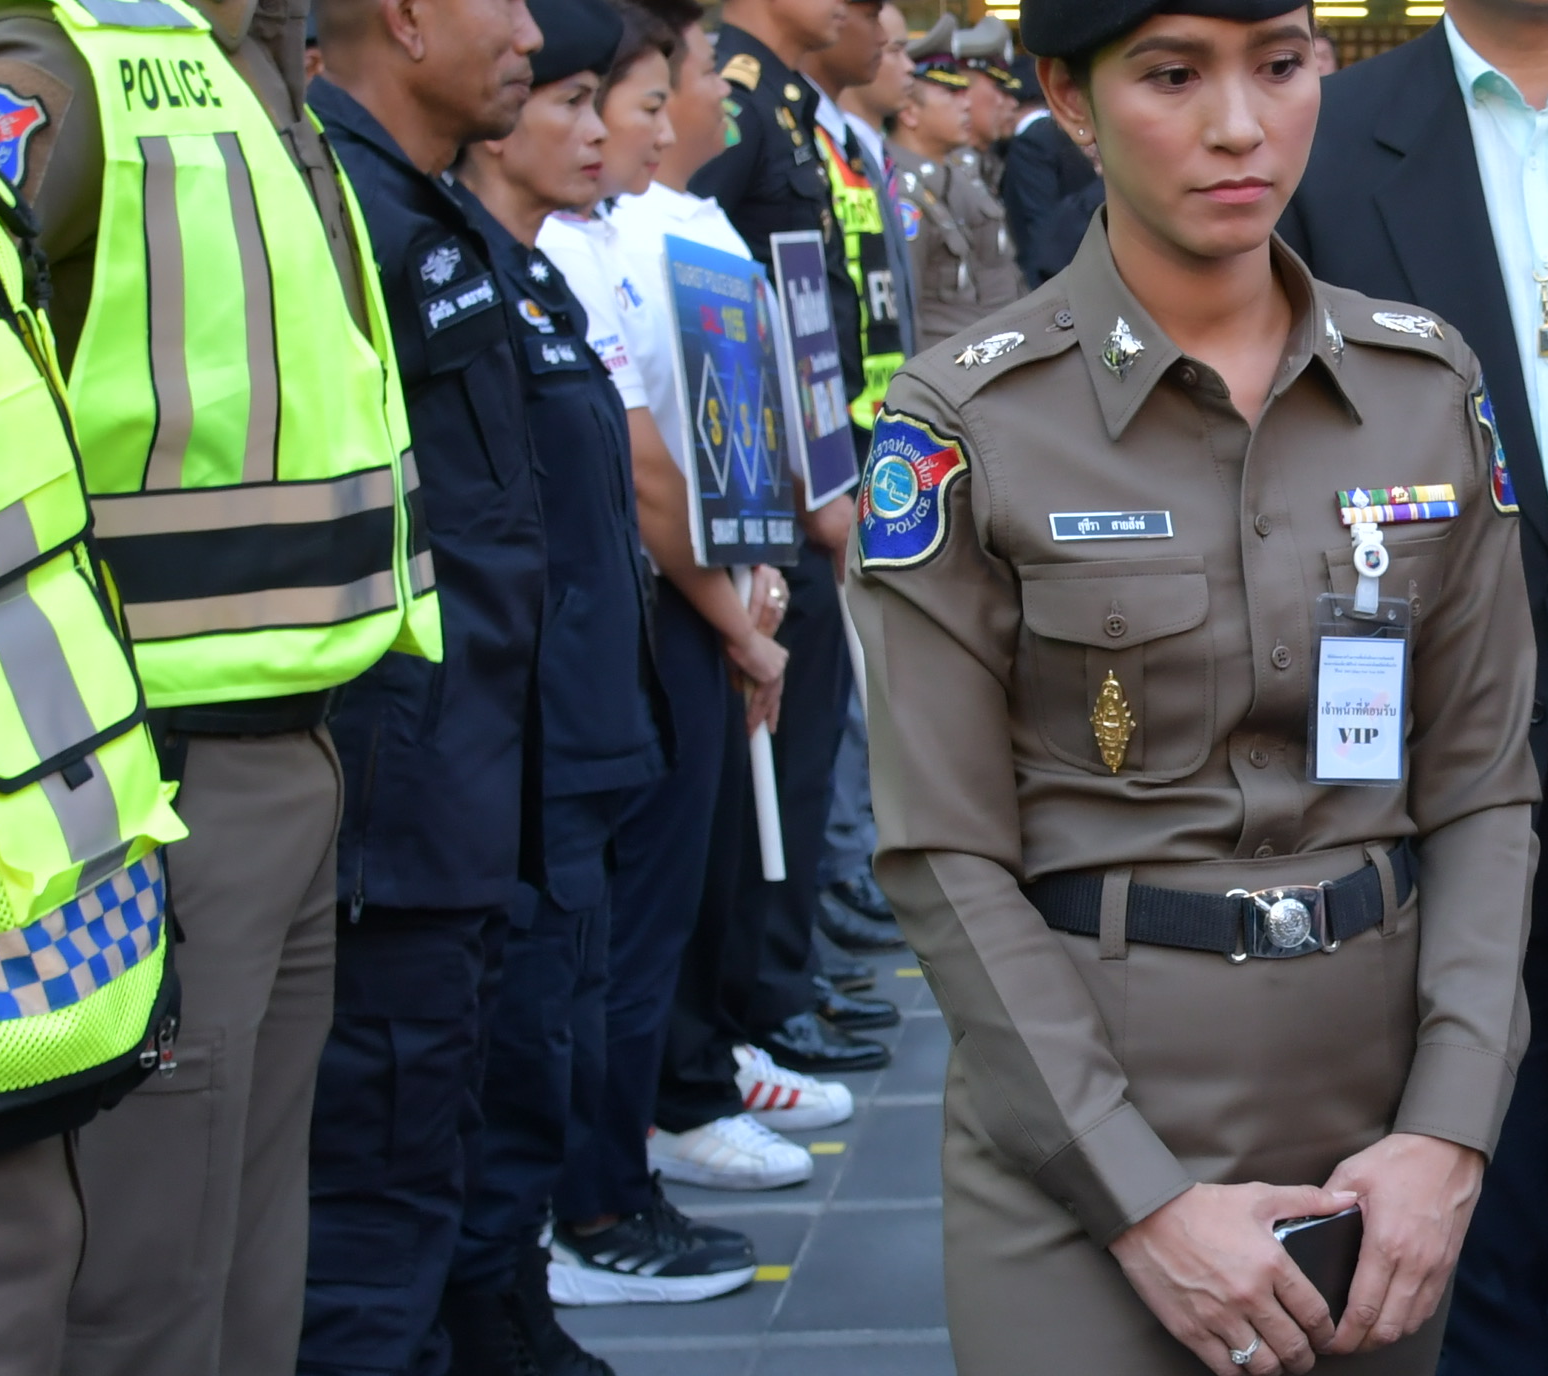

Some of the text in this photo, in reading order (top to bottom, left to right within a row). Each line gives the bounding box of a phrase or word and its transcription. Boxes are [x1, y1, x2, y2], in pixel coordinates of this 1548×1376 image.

[119, 58, 223, 112] POLICE
[886, 496, 931, 537] POLICE
[1320, 698, 1398, 717] เจ้าหน้าที่ต้อนรับ
[1338, 726, 1380, 745] VIP
